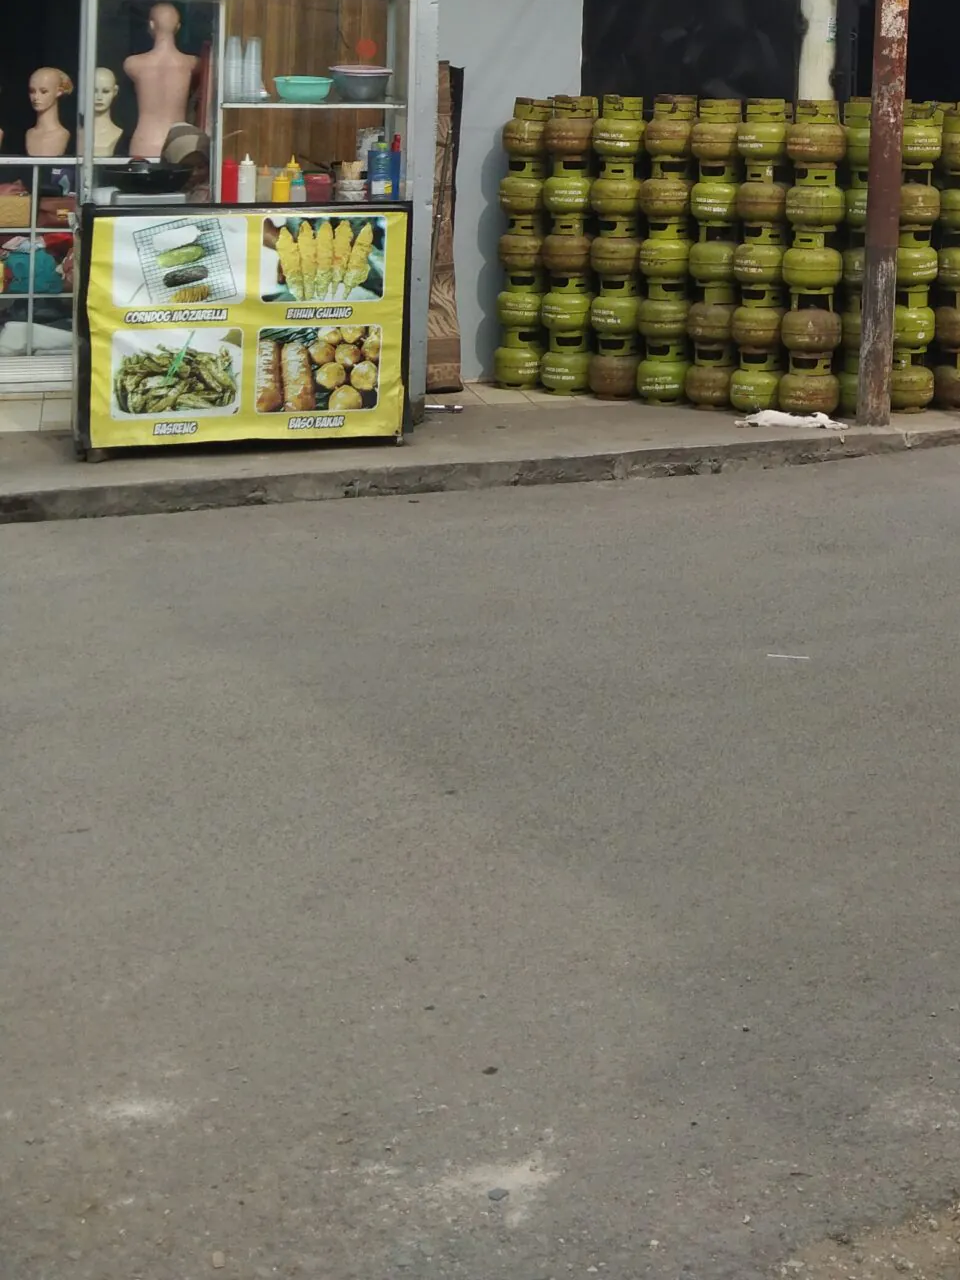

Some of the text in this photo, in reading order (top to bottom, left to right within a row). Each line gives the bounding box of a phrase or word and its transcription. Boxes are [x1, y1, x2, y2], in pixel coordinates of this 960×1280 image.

[124, 308, 229, 324] CORNDOG MOZARELLA
[286, 306, 353, 320] BIHUN GULUNG
[152, 422, 198, 436] BASRENG
[287, 416, 345, 430] BASO BAKAR
